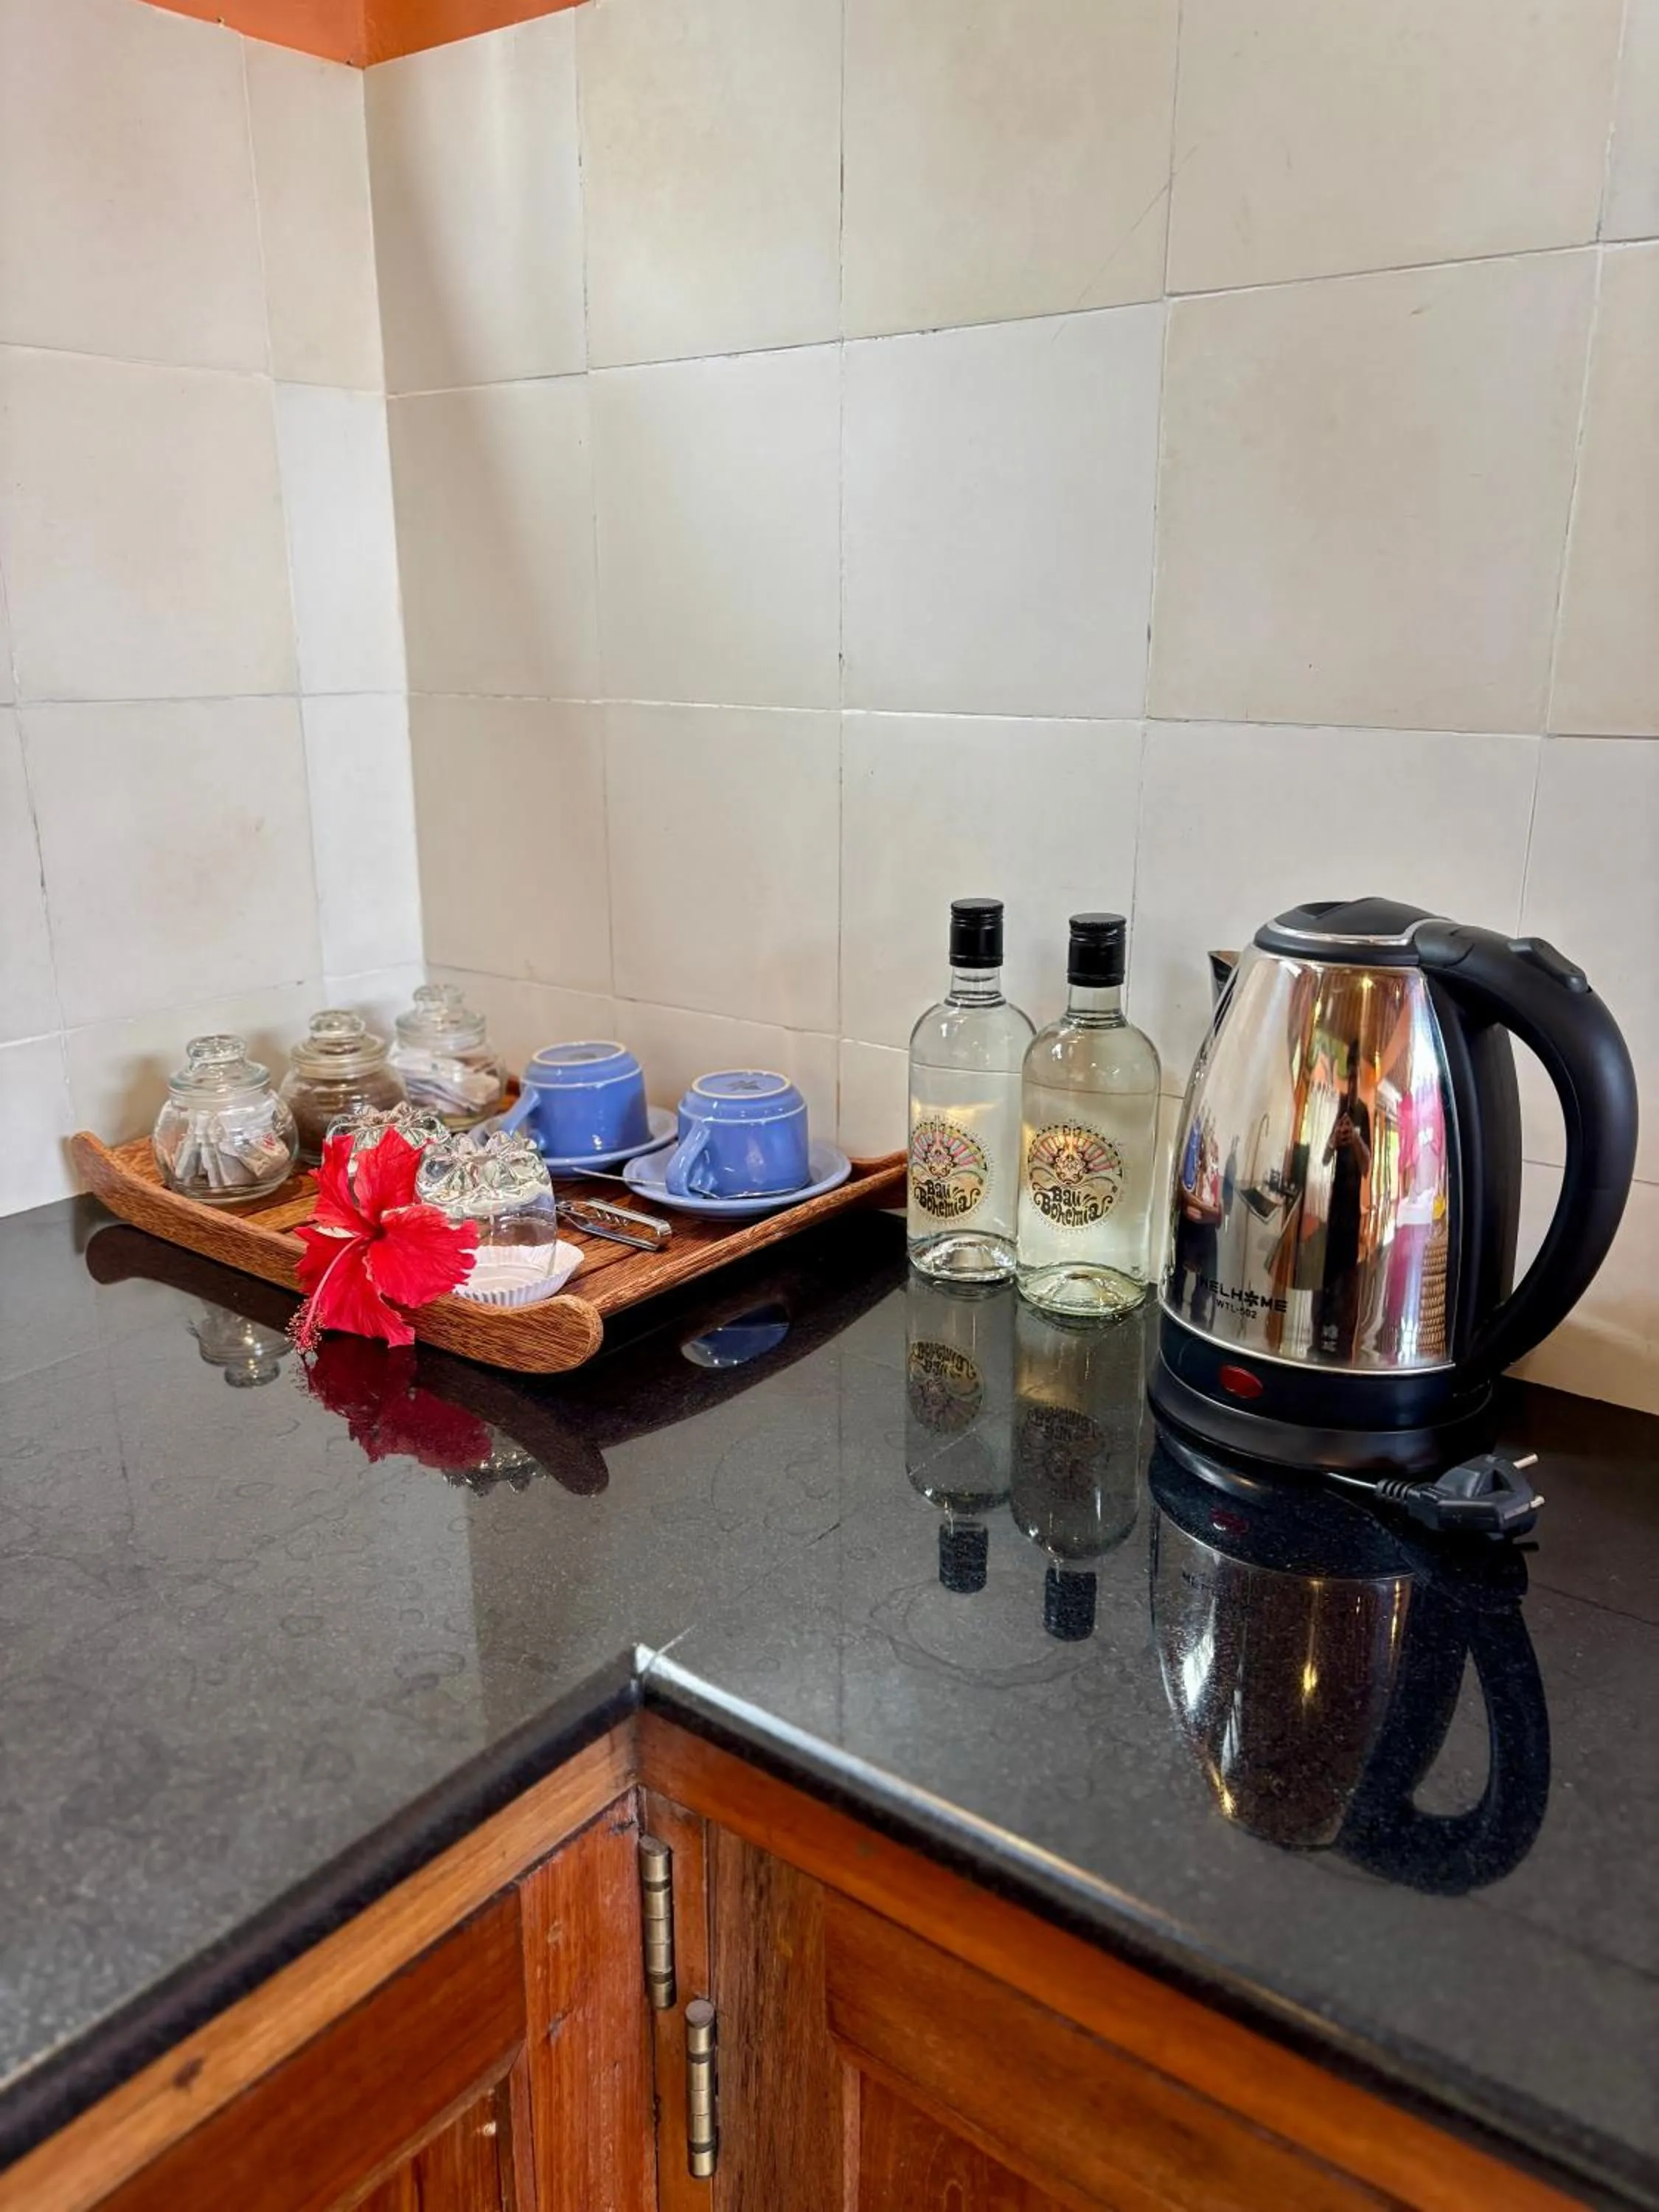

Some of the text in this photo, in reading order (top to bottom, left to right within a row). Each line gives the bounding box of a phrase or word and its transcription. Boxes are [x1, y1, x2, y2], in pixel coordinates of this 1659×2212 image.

[914, 1186, 981, 1218] Bohemia
[924, 1180, 951, 1198] Bali
[1048, 1186, 1082, 1206] Bali
[1034, 1192, 1113, 1226] Bohemia
